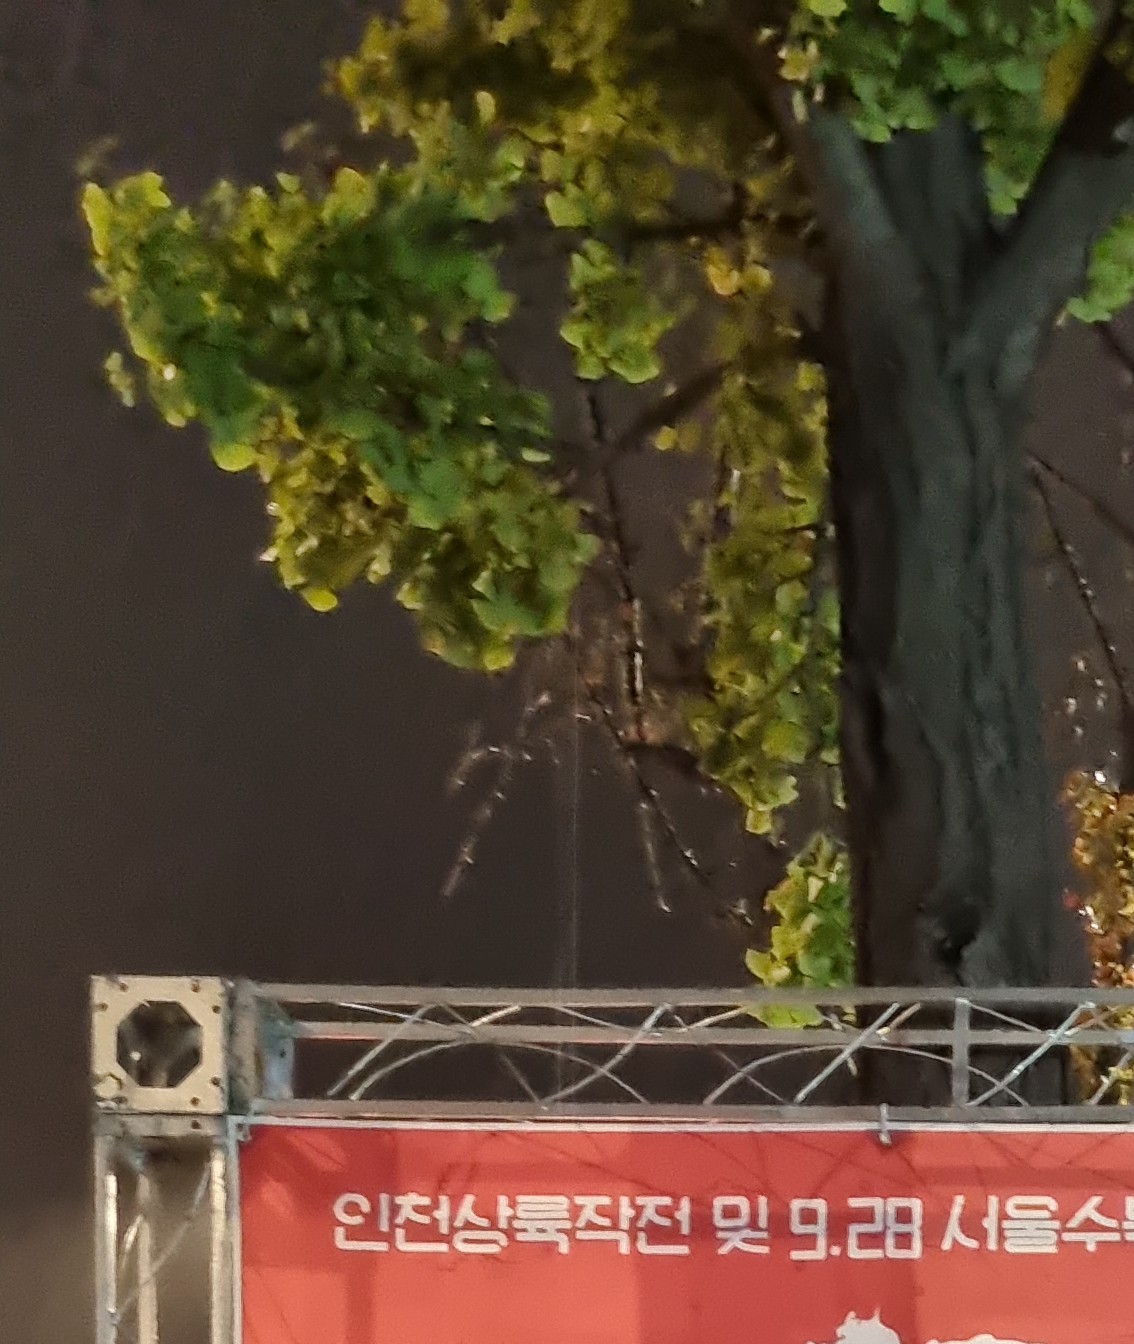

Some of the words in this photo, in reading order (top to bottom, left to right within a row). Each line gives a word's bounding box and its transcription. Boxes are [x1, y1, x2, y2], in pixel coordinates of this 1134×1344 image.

[332, 1192, 691, 1256] 인천상륙작전
[711, 1193, 771, 1256] 및
[789, 1196, 924, 1262] 9.28
